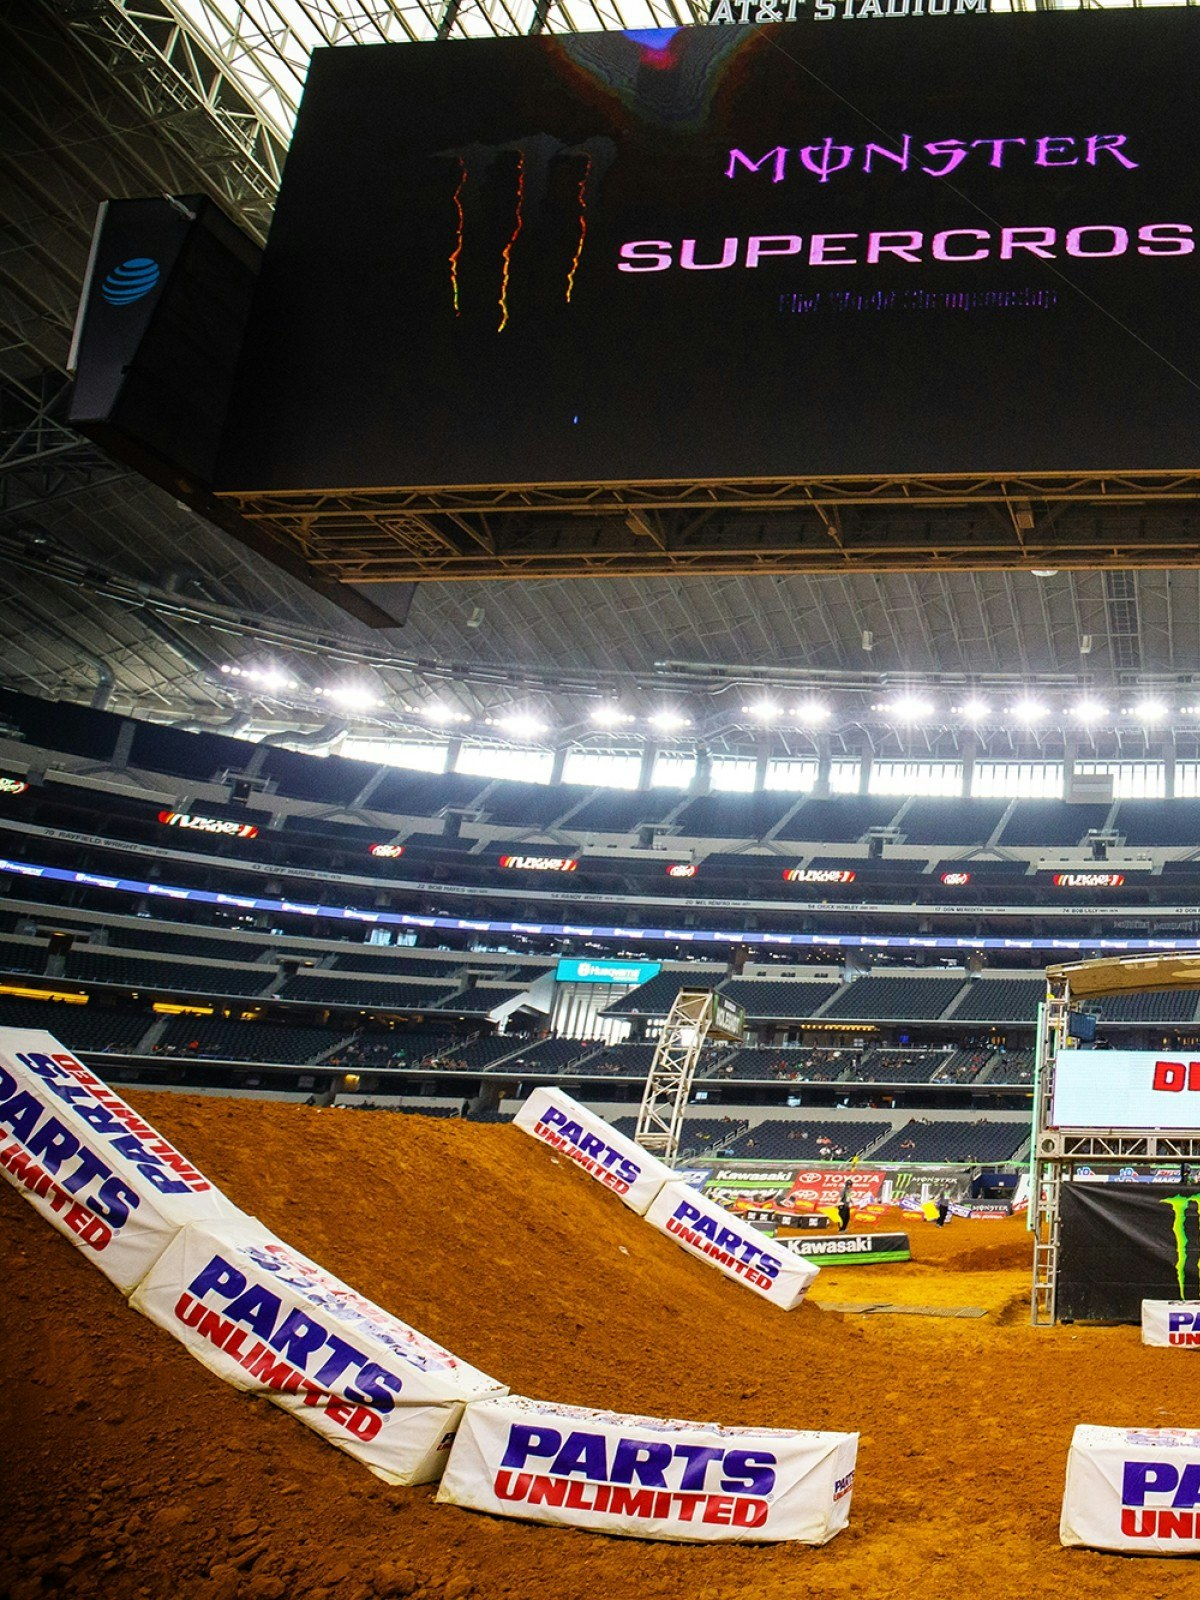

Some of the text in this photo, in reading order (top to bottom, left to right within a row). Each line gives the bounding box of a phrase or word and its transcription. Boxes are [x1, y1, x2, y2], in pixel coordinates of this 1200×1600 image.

[709, 0, 797, 24] AT&T
[725, 133, 1139, 182] MONSTER
[16, 1053, 193, 1193] PARTS
[51, 1054, 210, 1192] UNLIMITED
[534, 1121, 630, 1197] UNLIMITED
[541, 1105, 642, 1183] PARTS
[716, 1170, 792, 1182] Kawasaki
[824, 1174, 880, 1184] TOYOTA
[666, 1217, 772, 1291] UNLIMITED
[673, 1200, 782, 1279] PARTS
[787, 1237, 872, 1255] Kawasaki
[174, 1293, 383, 1442] UNLIMITED
[188, 1254, 402, 1414] PARTS
[500, 1423, 777, 1497] PARTS
[494, 1469, 770, 1528] UNLIMITED
